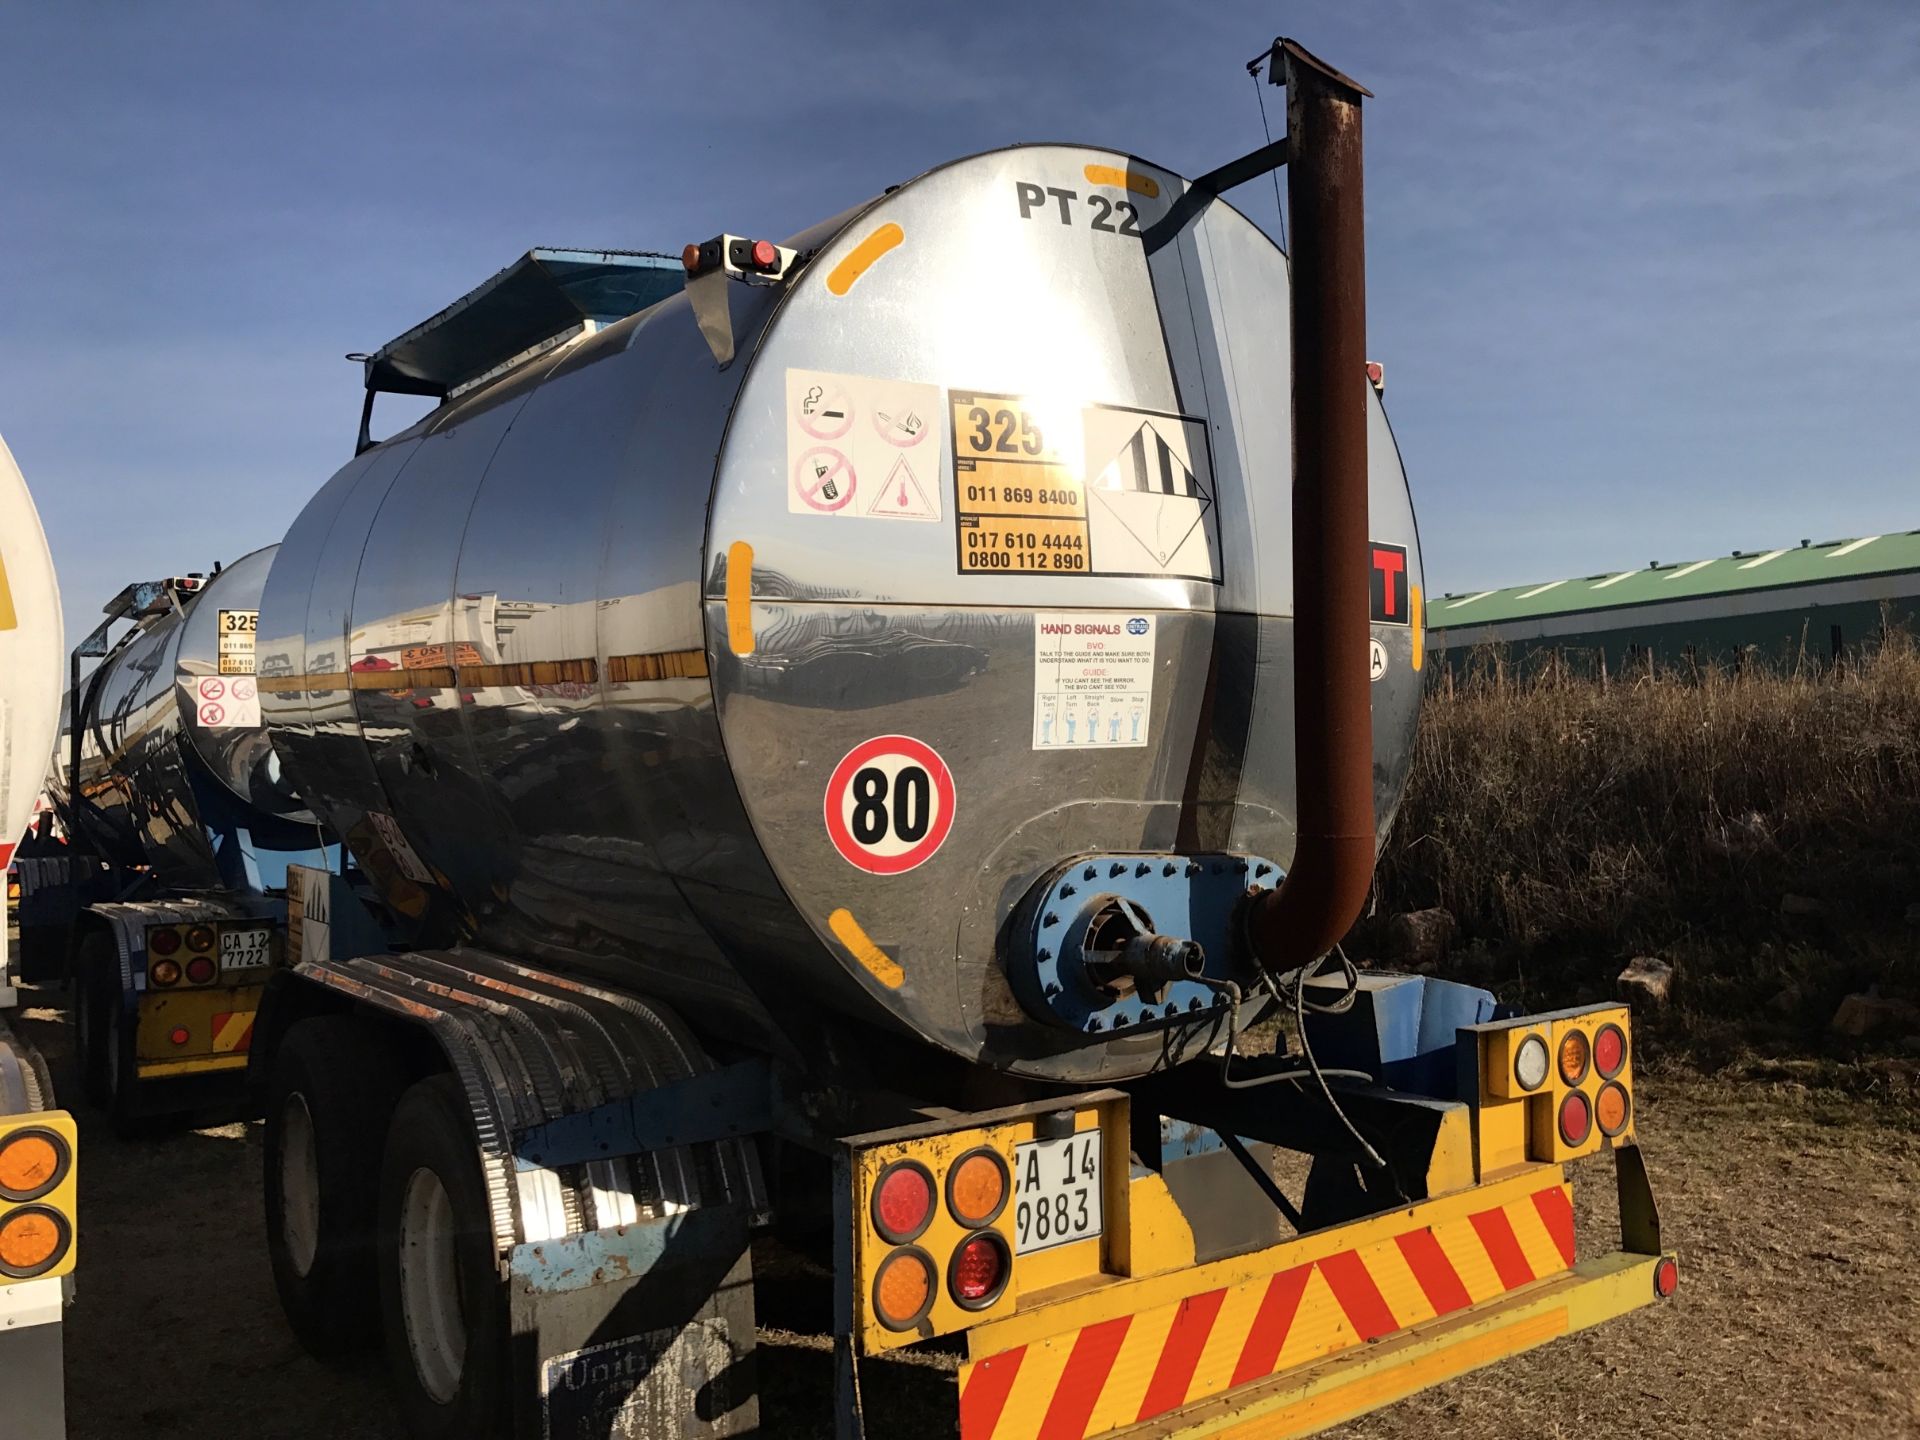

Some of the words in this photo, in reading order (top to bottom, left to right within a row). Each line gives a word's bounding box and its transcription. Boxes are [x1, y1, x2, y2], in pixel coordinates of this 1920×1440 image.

[1016, 181, 1078, 226] PT
[1087, 194, 1141, 239] 22
[968, 406, 1050, 456] 325
[967, 485, 997, 502] 011
[1003, 487, 1034, 504] 869
[1038, 489, 1078, 506] 8400
[967, 531, 999, 548] 017
[1004, 532, 1036, 549] 610
[1042, 533, 1083, 550] 4444
[968, 551, 1011, 568] 0800
[1017, 552, 1048, 569] 112
[1053, 553, 1084, 570] 890
[1372, 549, 1404, 616] T
[1040, 623, 1072, 635] HAND
[1074, 624, 1121, 635] SIGNALS
[852, 766, 930, 845] 80
[223, 934, 241, 950] CA
[248, 932, 266, 949] 12
[227, 949, 263, 967] 7722
[1061, 1138, 1096, 1186] 14
[1016, 1187, 1089, 1245] 9883
